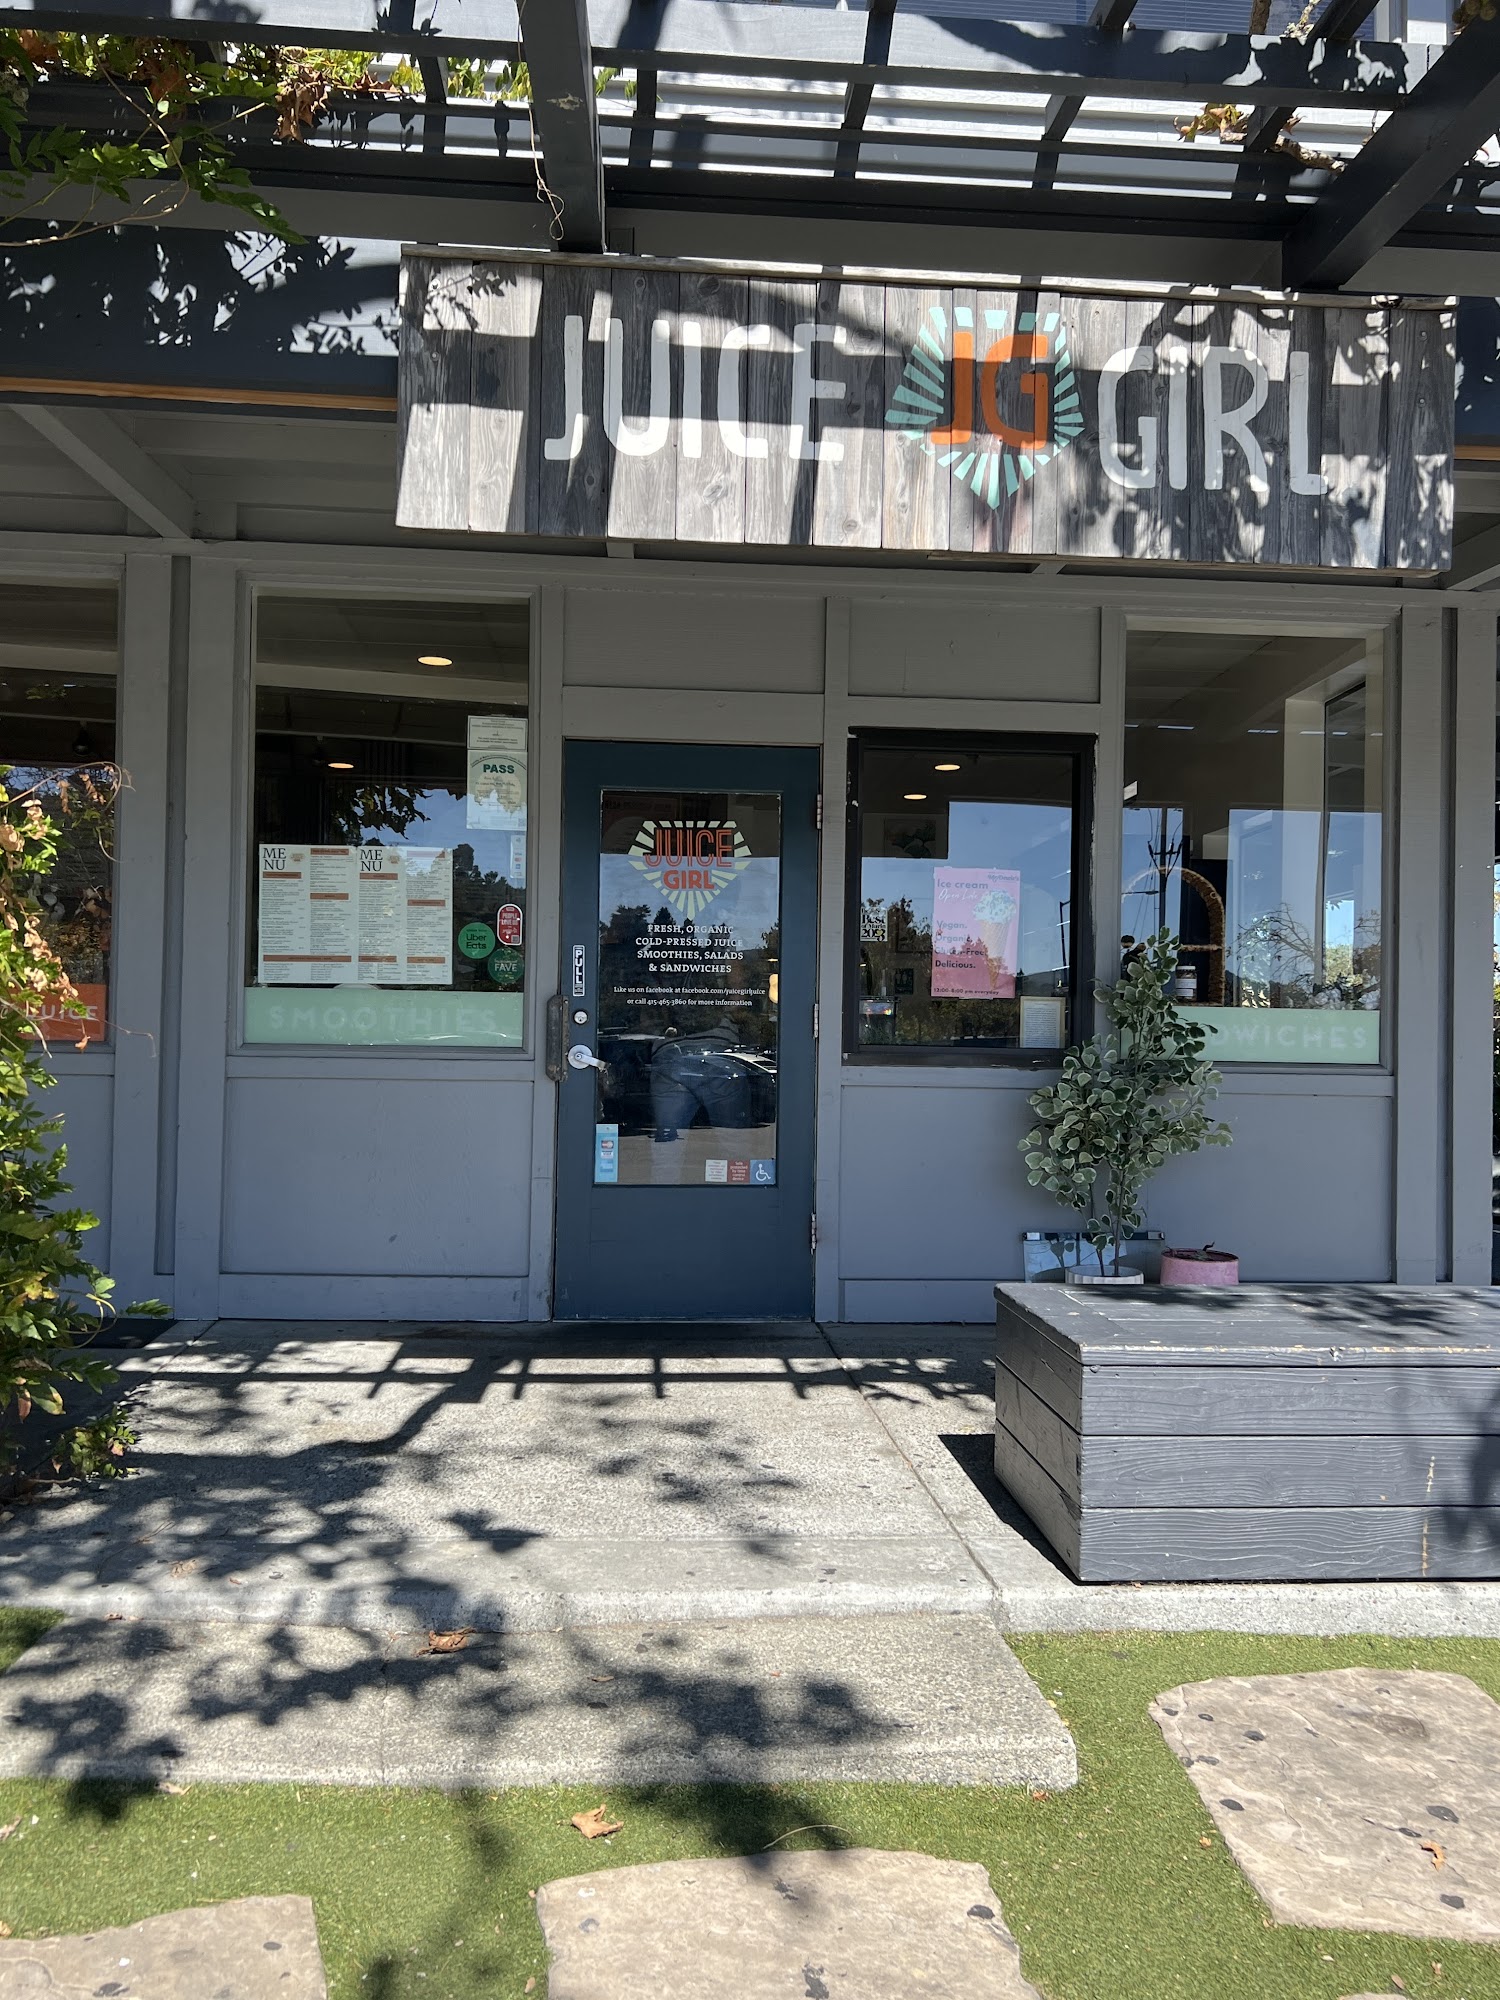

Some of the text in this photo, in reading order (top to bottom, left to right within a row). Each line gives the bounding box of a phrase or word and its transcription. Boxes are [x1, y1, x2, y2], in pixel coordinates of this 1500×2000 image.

[543, 314, 1330, 497] JUICE JG GIRL
[483, 763, 515, 774] PASS
[262, 847, 287, 860] ME
[644, 829, 732, 867] JUICE
[359, 849, 383, 861] ME
[263, 859, 286, 871] NU
[360, 860, 383, 872] NU
[663, 870, 715, 889] GIRL
[937, 879, 989, 890] Ice cream
[938, 888, 959, 903] Open
[647, 924, 734, 935] FRESH, ORGANIC
[936, 920, 968, 930] Vegan.
[466, 933, 487, 941] Uber
[635, 937, 743, 948] COLD-PRESSED JUICE
[466, 941, 487, 949] Eats
[637, 950, 744, 961] SMOOTHIES, SALADS
[494, 962, 518, 972] FAVE
[575, 949, 583, 984] PULL
[648, 963, 732, 973] & SANDWICHES
[935, 959, 976, 968] Delicious.
[613, 986, 627, 994] Like
[645, 986, 674, 994] facebook
[715, 998, 752, 1006] information
[269, 1004, 498, 1033] SMOOTHIES
[1208, 1023, 1368, 1049] DWICHES
